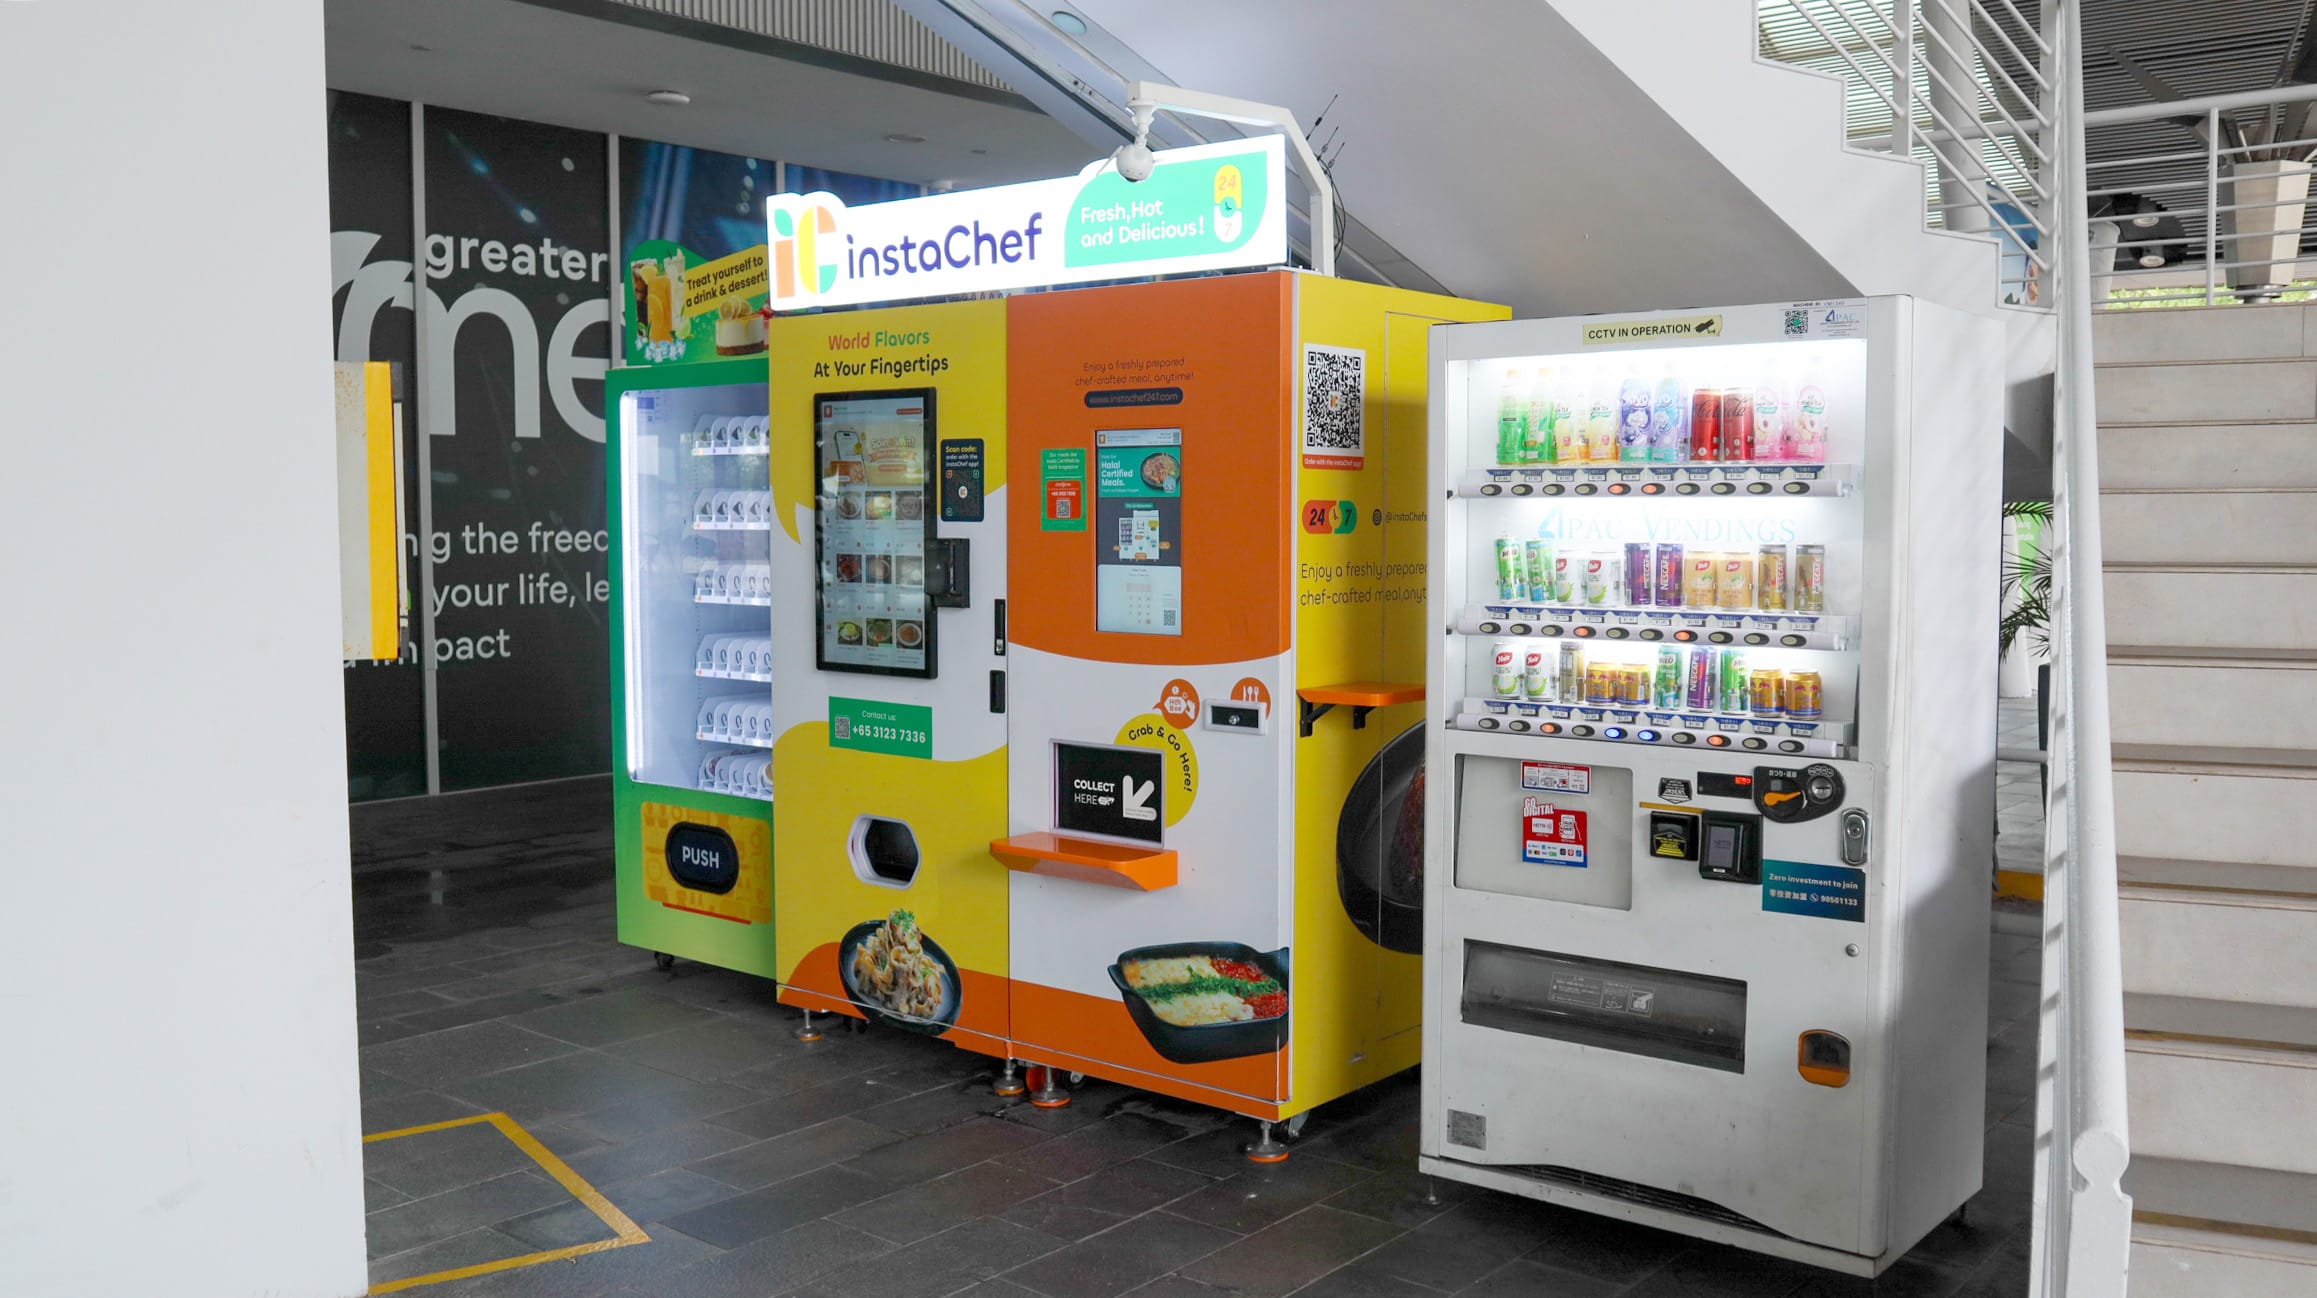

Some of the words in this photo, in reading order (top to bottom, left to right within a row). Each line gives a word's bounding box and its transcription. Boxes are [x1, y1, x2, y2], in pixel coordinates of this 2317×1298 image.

[1080, 232, 1114, 249] and
[1118, 215, 1205, 246] Delicious!
[846, 211, 1043, 280] instaChef
[425, 233, 608, 283] greater
[685, 269, 711, 290] Treat
[713, 259, 749, 287] yourself
[751, 254, 764, 270] to
[695, 285, 719, 306] drink
[730, 269, 769, 297] dessert!
[828, 330, 871, 351] World
[874, 328, 930, 348] Flavors
[1587, 328, 1616, 340] CCTV
[1617, 327, 1629, 338] IN
[1630, 322, 1692, 337] OPERATION
[813, 359, 831, 378] At
[833, 358, 867, 377] Your
[869, 354, 949, 379] Fingertips
[1084, 362, 1107, 373] Enjoy
[1115, 359, 1144, 371] freshly
[1146, 357, 1185, 370] prepared
[1075, 374, 1127, 386] chef-crafted
[1154, 371, 1194, 384] anytime!
[1309, 508, 1326, 526] 24
[1344, 509, 1353, 526] 7
[461, 521, 520, 555] the
[1301, 563, 1332, 582] Enjoy
[1335, 565, 1343, 577] a
[1345, 560, 1382, 581] freshly
[432, 582, 510, 617] your
[518, 571, 576, 609] life,
[1300, 588, 1372, 608] chef-crafted
[861, 709, 885, 720] Contact
[852, 724, 871, 737] +65
[873, 726, 897, 740] 3123
[899, 728, 927, 744] 7336
[1128, 723, 1154, 741] Grab
[1157, 727, 1165, 738] &
[1167, 734, 1181, 751] Go
[1178, 752, 1193, 793] Here!
[1073, 778, 1116, 793] COLLECT
[1073, 793, 1098, 805] HERE
[1523, 804, 1554, 817] DIGITAL
[681, 845, 720, 869] PUSH
[1768, 873, 1787, 882] Zero
[1787, 876, 1832, 888] investment
[1833, 880, 1842, 888] to
[1842, 881, 1859, 890] join
